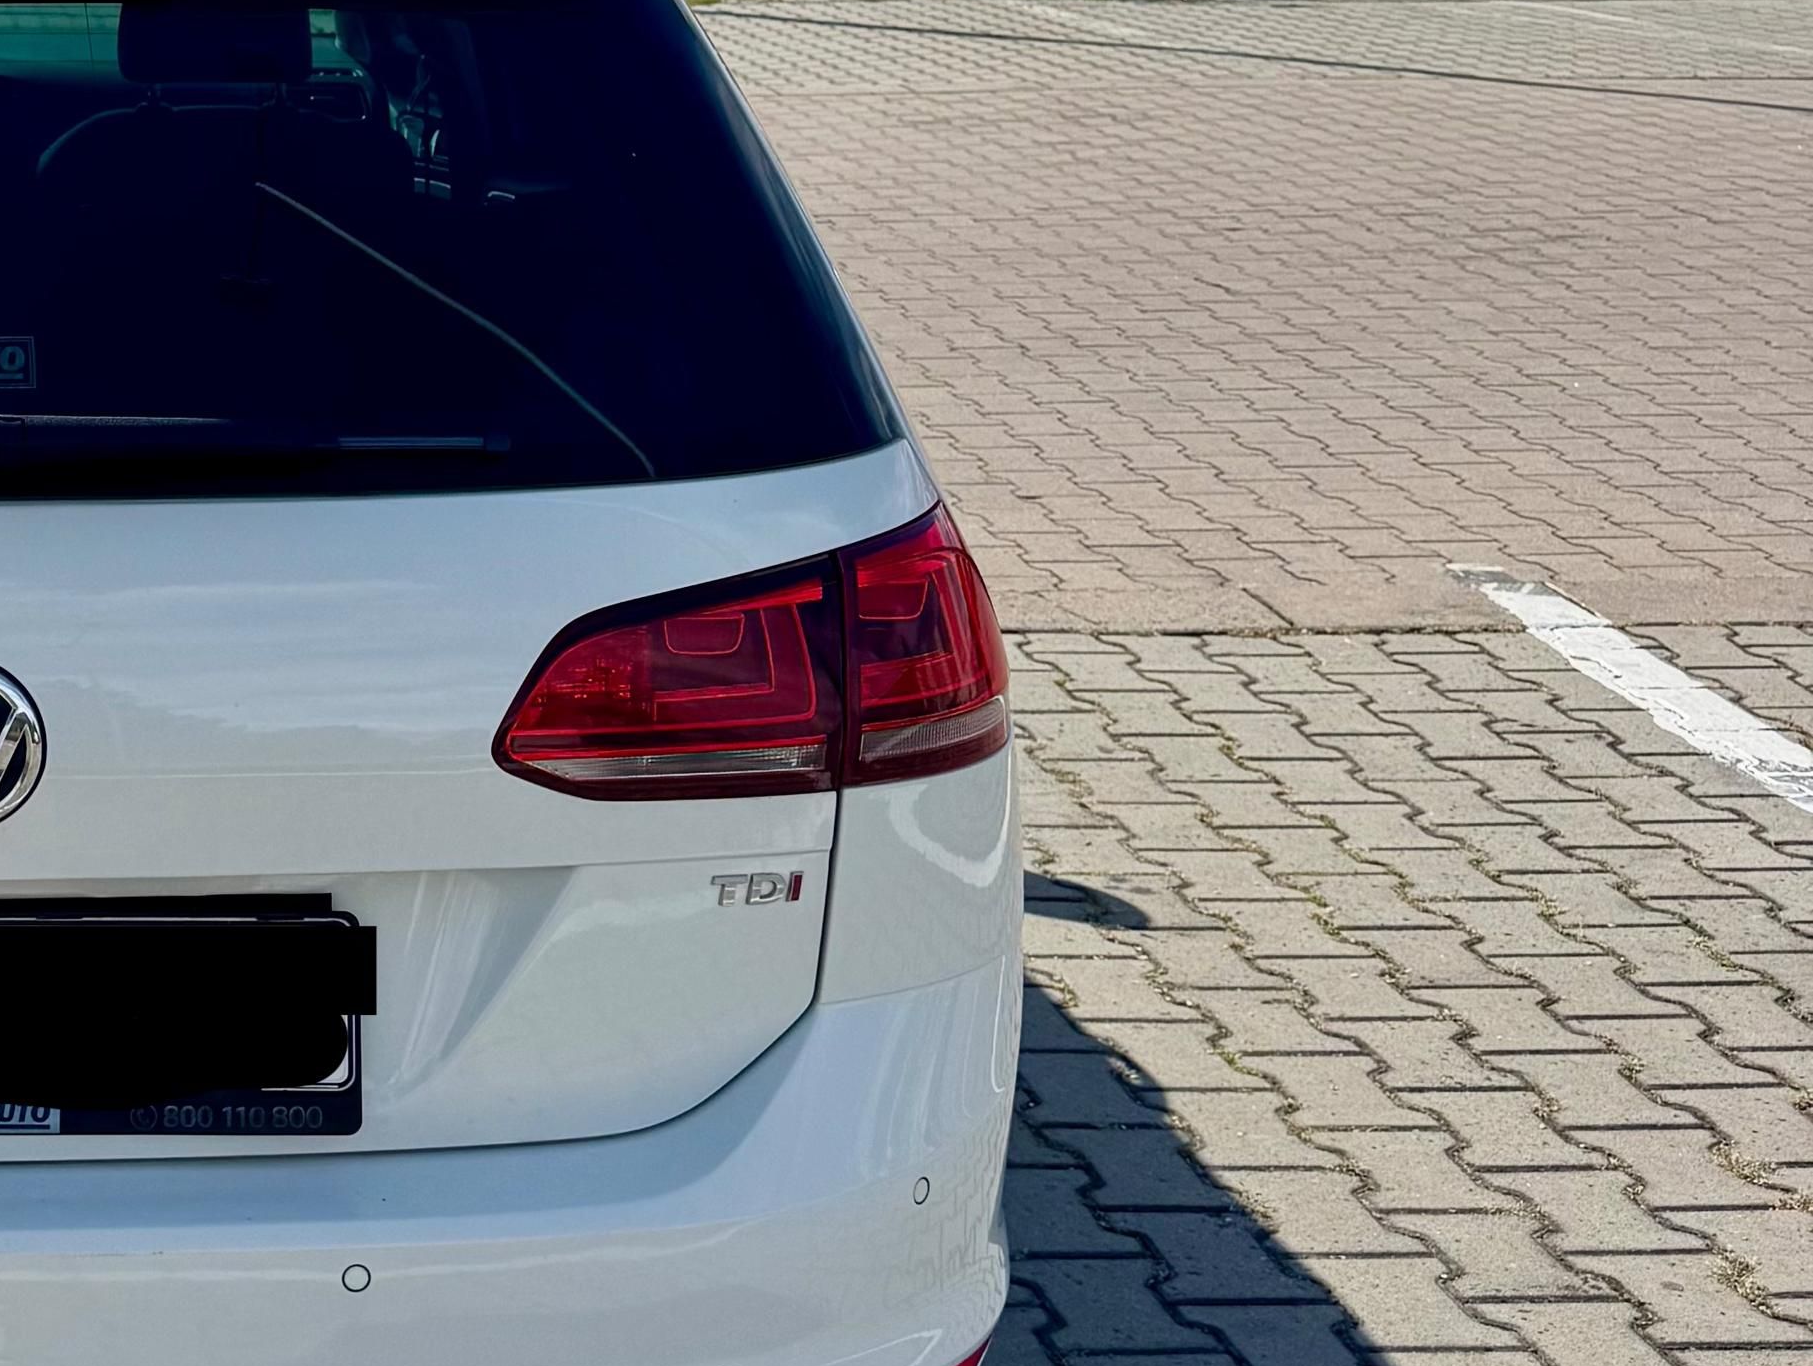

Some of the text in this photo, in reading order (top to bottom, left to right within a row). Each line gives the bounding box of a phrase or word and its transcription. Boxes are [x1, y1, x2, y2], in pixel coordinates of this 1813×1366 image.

[710, 870, 804, 907] TDI
[163, 1104, 324, 1129] 800 110 800
